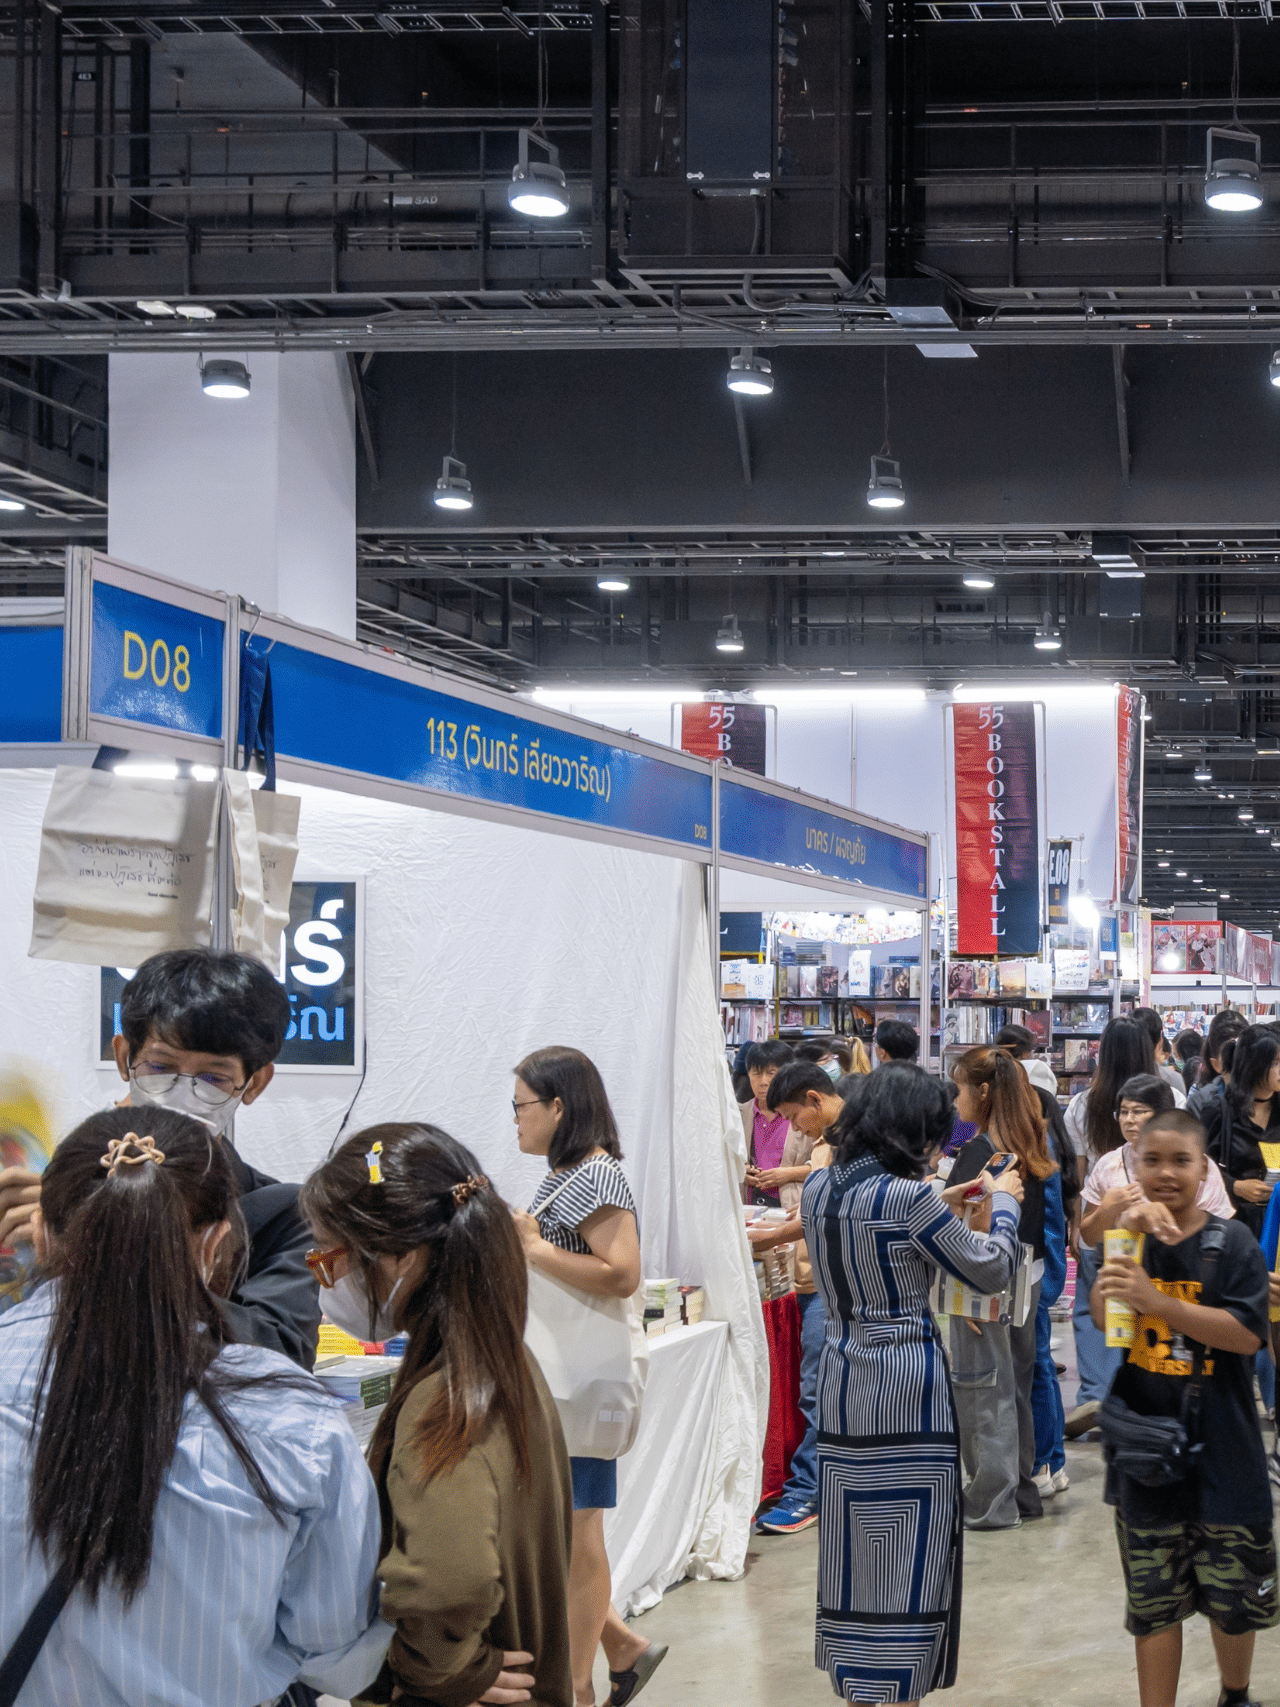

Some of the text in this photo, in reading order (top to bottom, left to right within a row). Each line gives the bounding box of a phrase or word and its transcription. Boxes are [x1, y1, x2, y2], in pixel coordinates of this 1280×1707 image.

[123, 630, 191, 692] D08
[708, 705, 735, 729] 55
[978, 705, 1004, 730] 55
[427, 717, 611, 803] 113 (วินทร์ เลียววาริณ)
[986, 733, 1006, 936] BOOKSTALL
